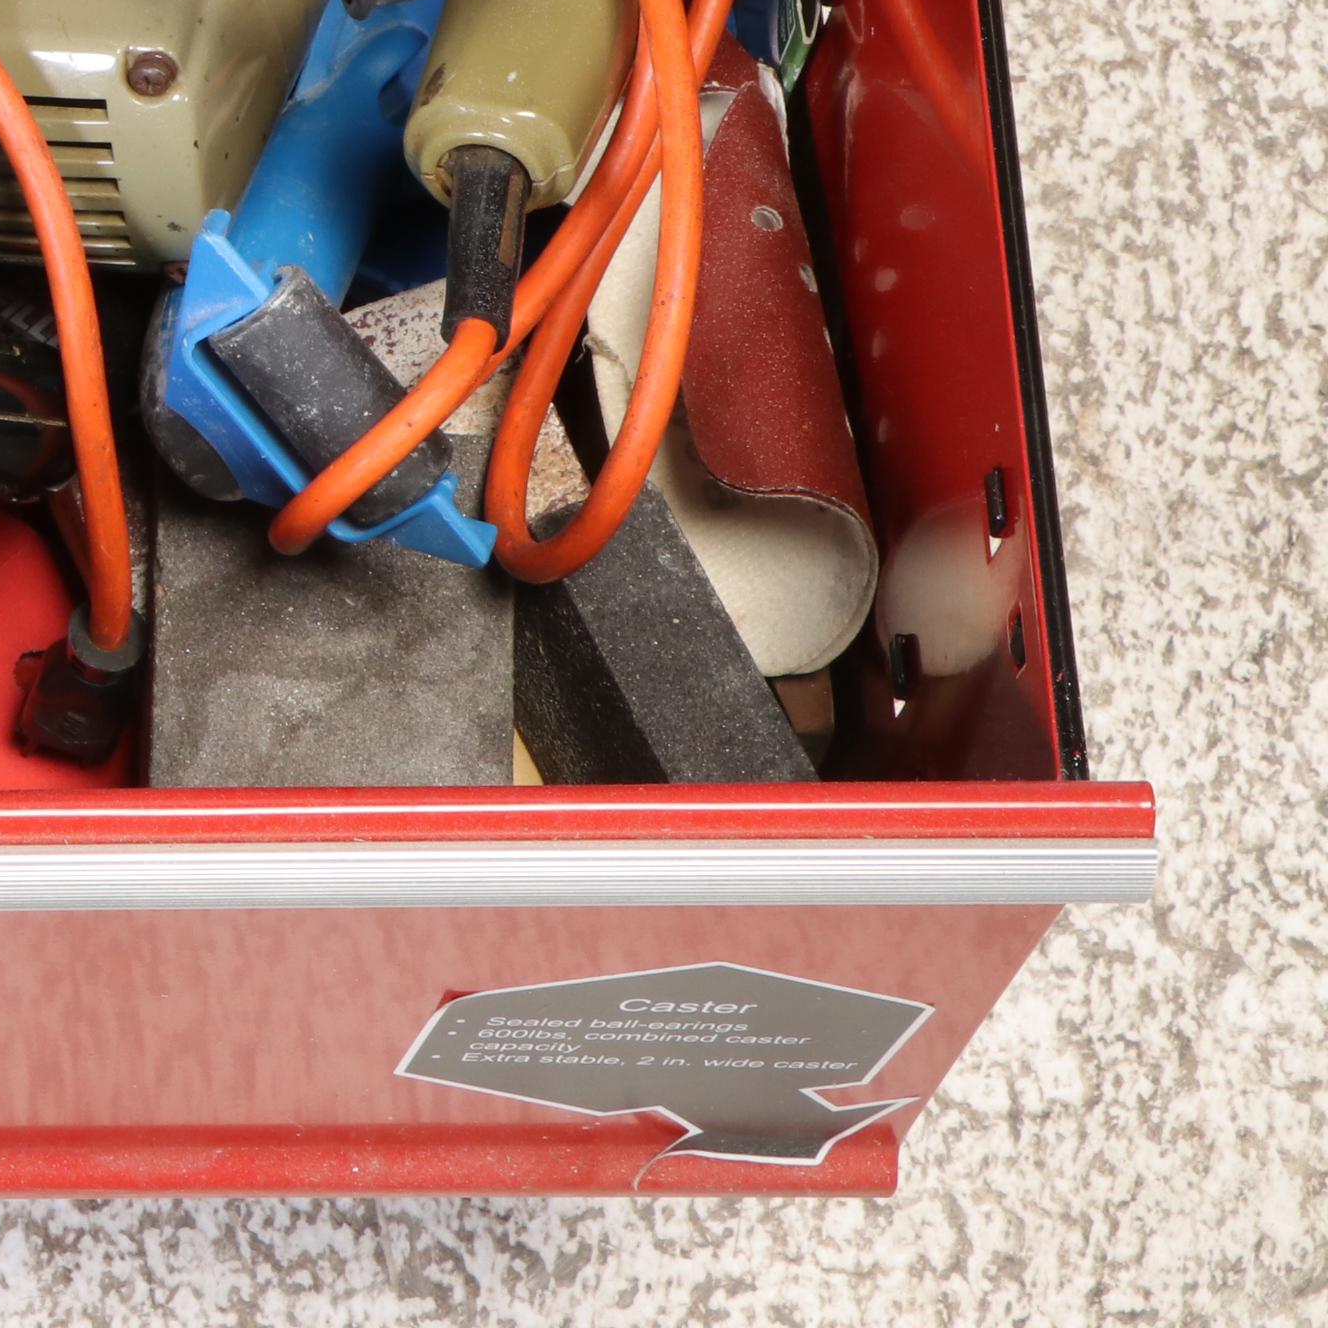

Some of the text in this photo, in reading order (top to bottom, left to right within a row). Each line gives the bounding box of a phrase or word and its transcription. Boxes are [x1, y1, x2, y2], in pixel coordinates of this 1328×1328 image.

[618, 998, 759, 1015] Caster
[486, 1016, 749, 1033] Sealed ball-earings
[477, 1028, 813, 1045] 600lbs. combined caster
[468, 1041, 582, 1054] capacity
[460, 1052, 859, 1071] Extra stable, 2 in. wide caster
